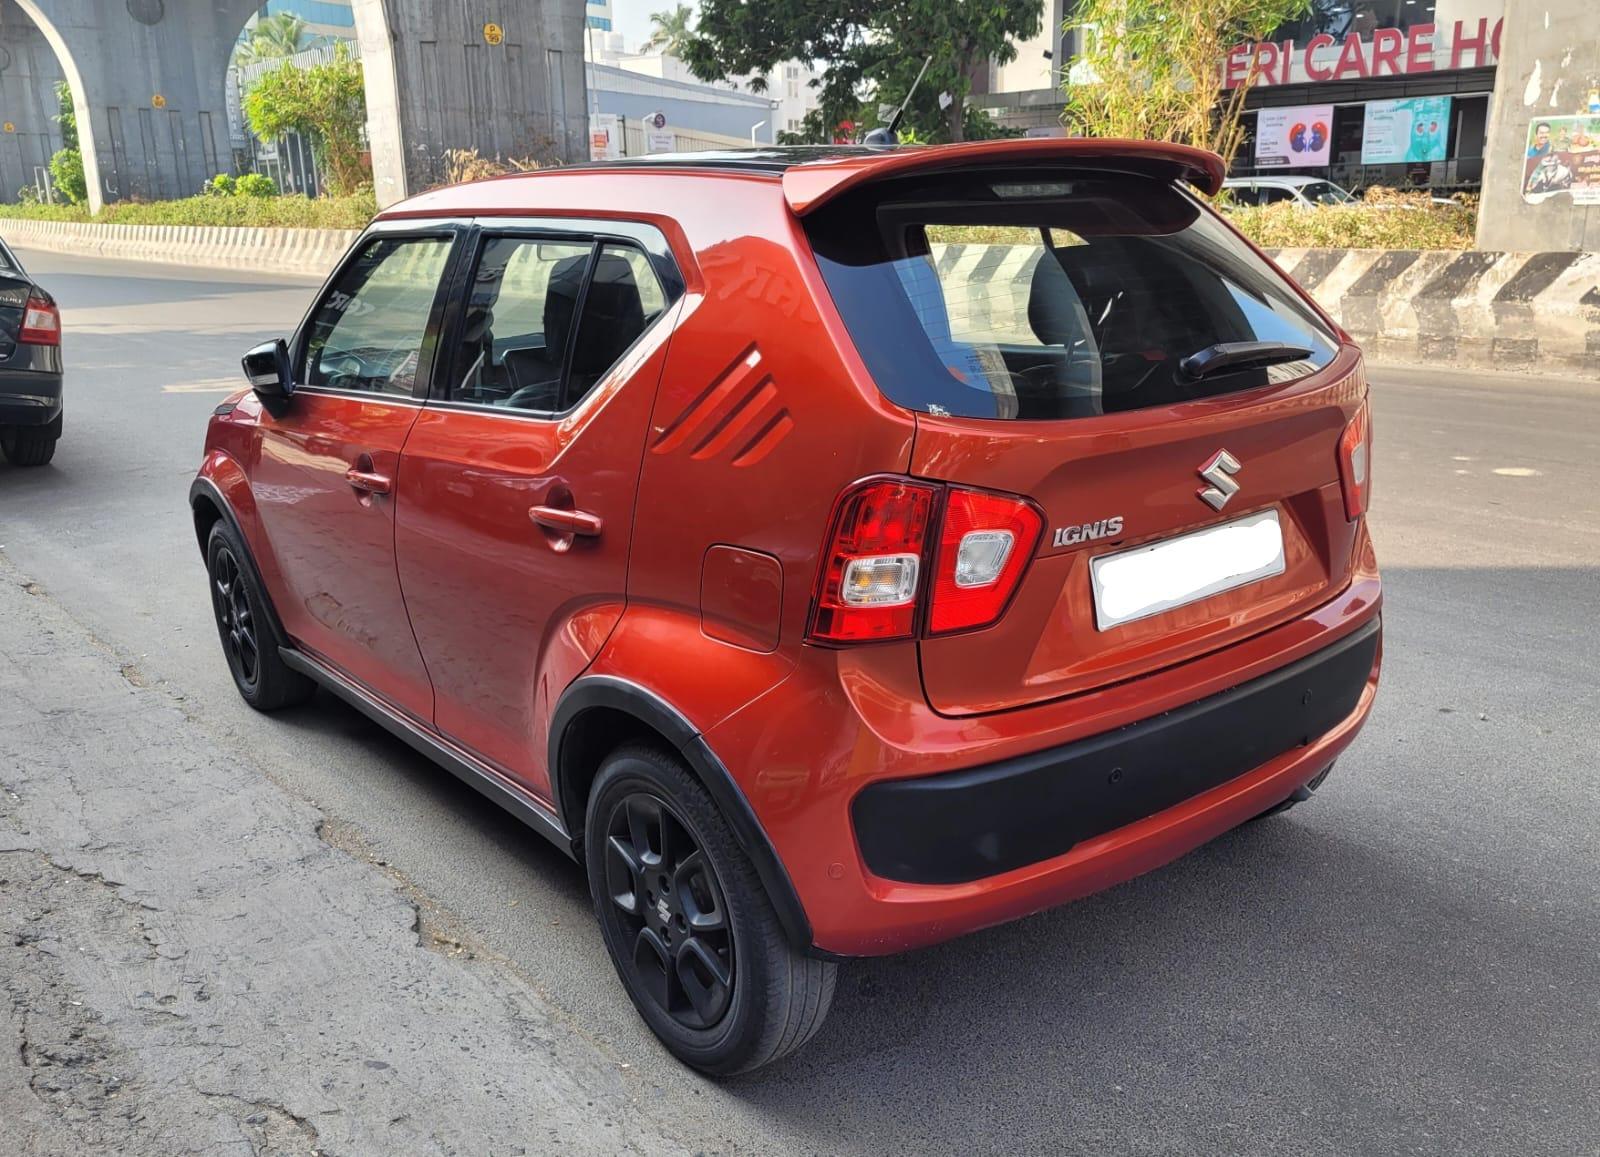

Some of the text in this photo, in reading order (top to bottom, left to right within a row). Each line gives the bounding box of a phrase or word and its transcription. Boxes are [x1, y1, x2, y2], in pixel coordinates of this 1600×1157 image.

[1215, 16, 1504, 89] ERI CARE H
[1053, 516, 1124, 548] IGNIS
